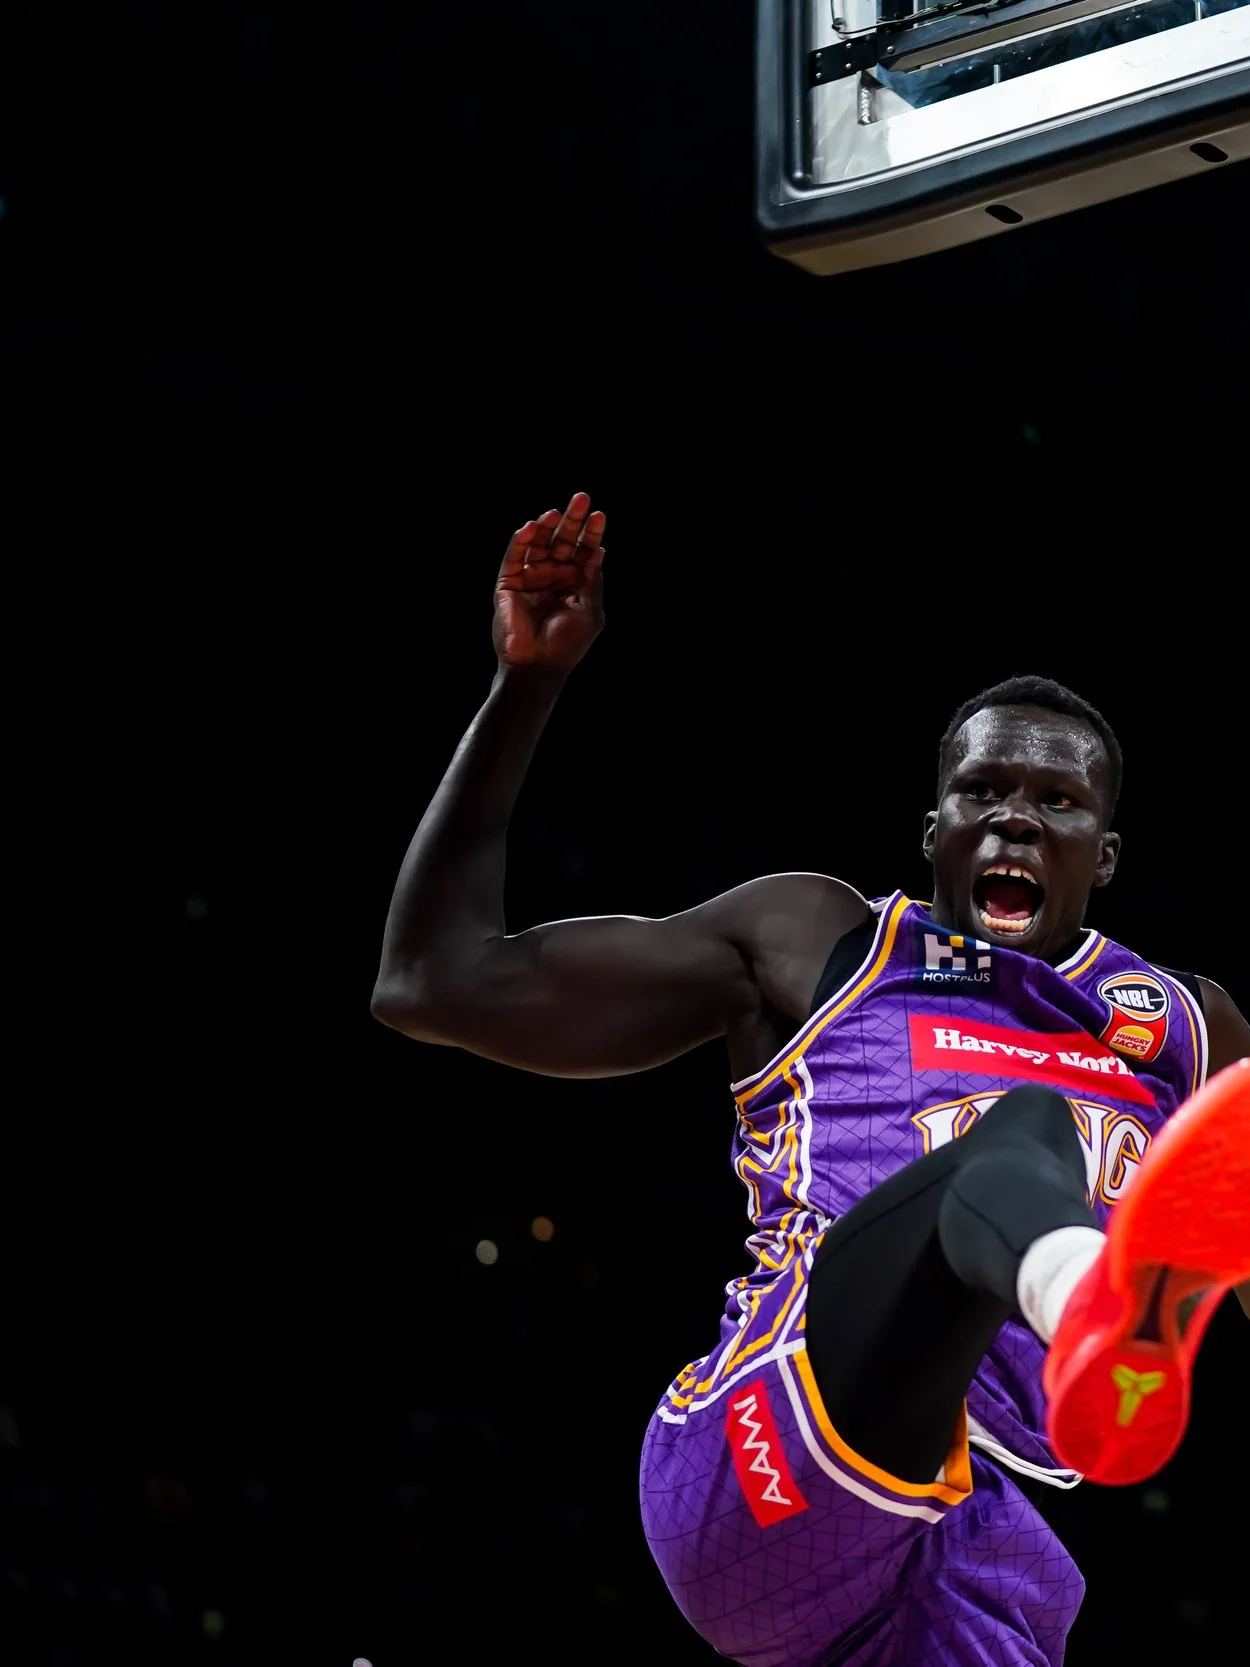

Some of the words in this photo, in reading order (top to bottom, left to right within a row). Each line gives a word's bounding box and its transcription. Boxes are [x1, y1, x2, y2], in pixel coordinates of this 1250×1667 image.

[922, 972, 991, 983] HOSTPLUS
[1112, 989, 1155, 1010] NBL
[932, 1027, 1051, 1065] Harvey
[1115, 1032, 1151, 1046] HUNGRY
[733, 1394, 793, 1506] AAMI
